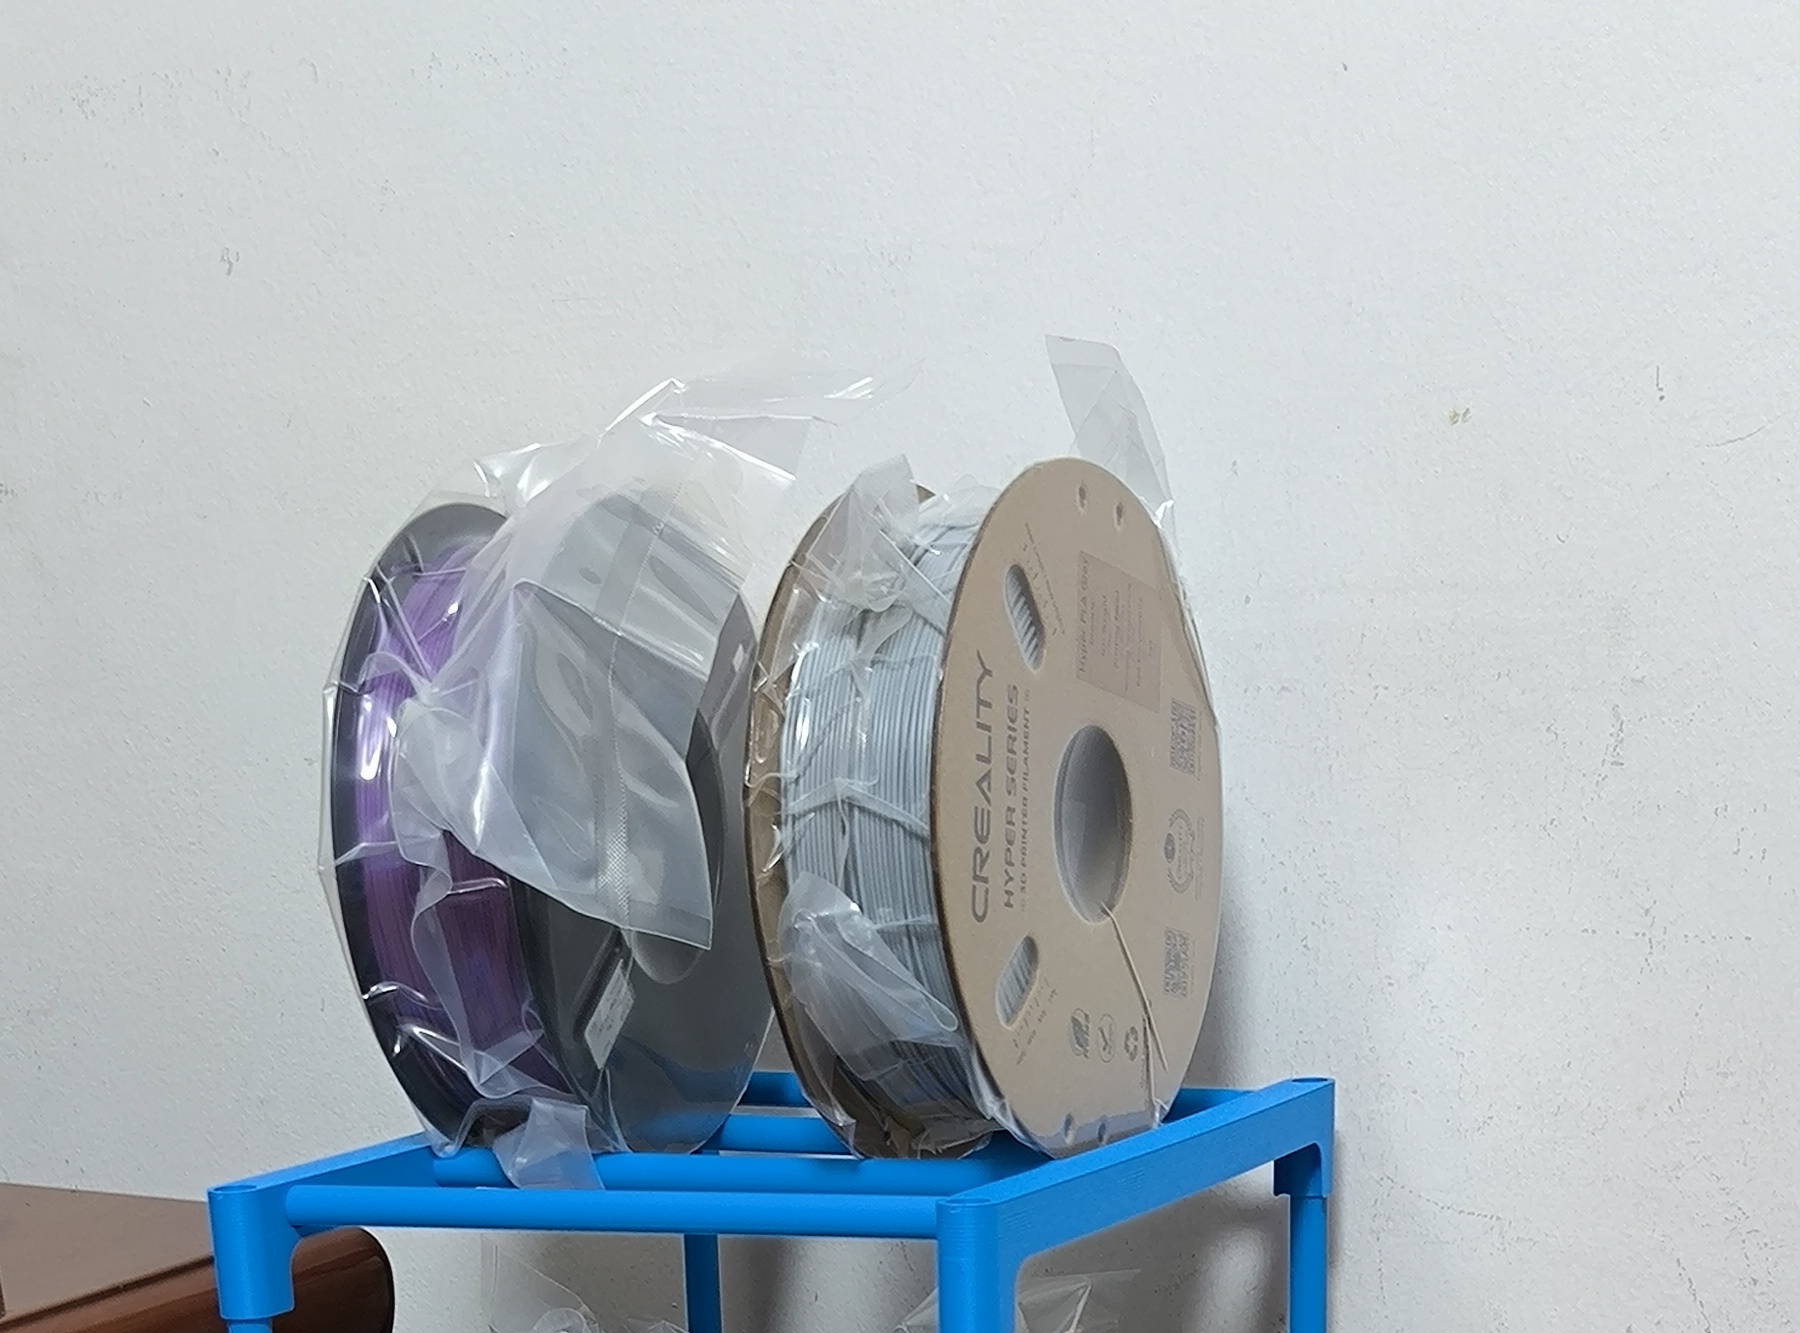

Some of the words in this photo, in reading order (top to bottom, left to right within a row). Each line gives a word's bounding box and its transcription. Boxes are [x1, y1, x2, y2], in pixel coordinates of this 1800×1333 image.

[971, 649, 993, 923] CREALITY
[1005, 684, 1019, 797] SERIES
[1022, 708, 1031, 791] FILAMENT
[1004, 805, 1016, 908] HYPER
